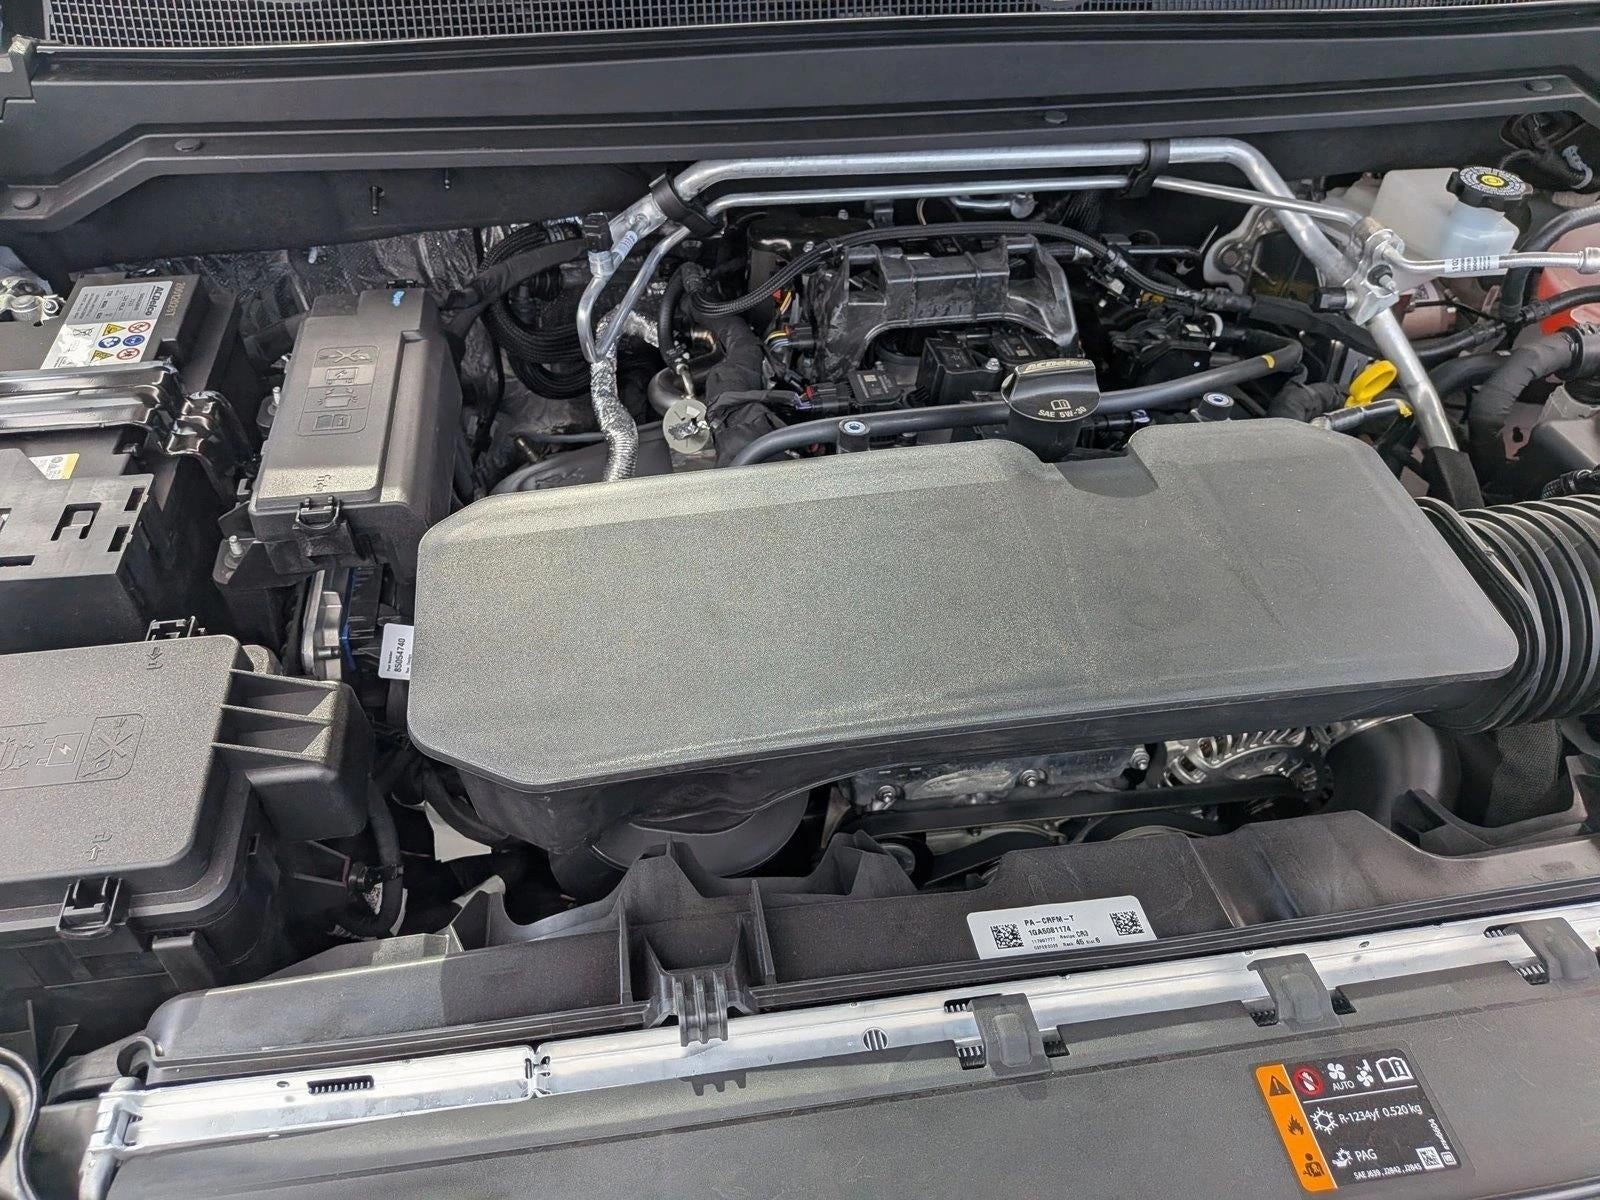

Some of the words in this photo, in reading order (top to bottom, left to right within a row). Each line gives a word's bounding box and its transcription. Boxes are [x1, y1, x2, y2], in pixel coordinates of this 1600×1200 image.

[145, 286, 164, 316] ACDelco
[1025, 360, 1089, 370] ACDelco
[1038, 409, 1056, 418] SAE
[1059, 406, 1087, 418] 5W-30
[394, 637, 406, 673] 85054740
[1332, 1080, 1355, 1091] AUTO
[1338, 1107, 1381, 1125] R-1234yf
[1382, 1104, 1409, 1118] 0.520
[1409, 1102, 1423, 1116] kg
[1354, 1148, 1378, 1162] PAG
[1353, 1170, 1367, 1180] SAE
